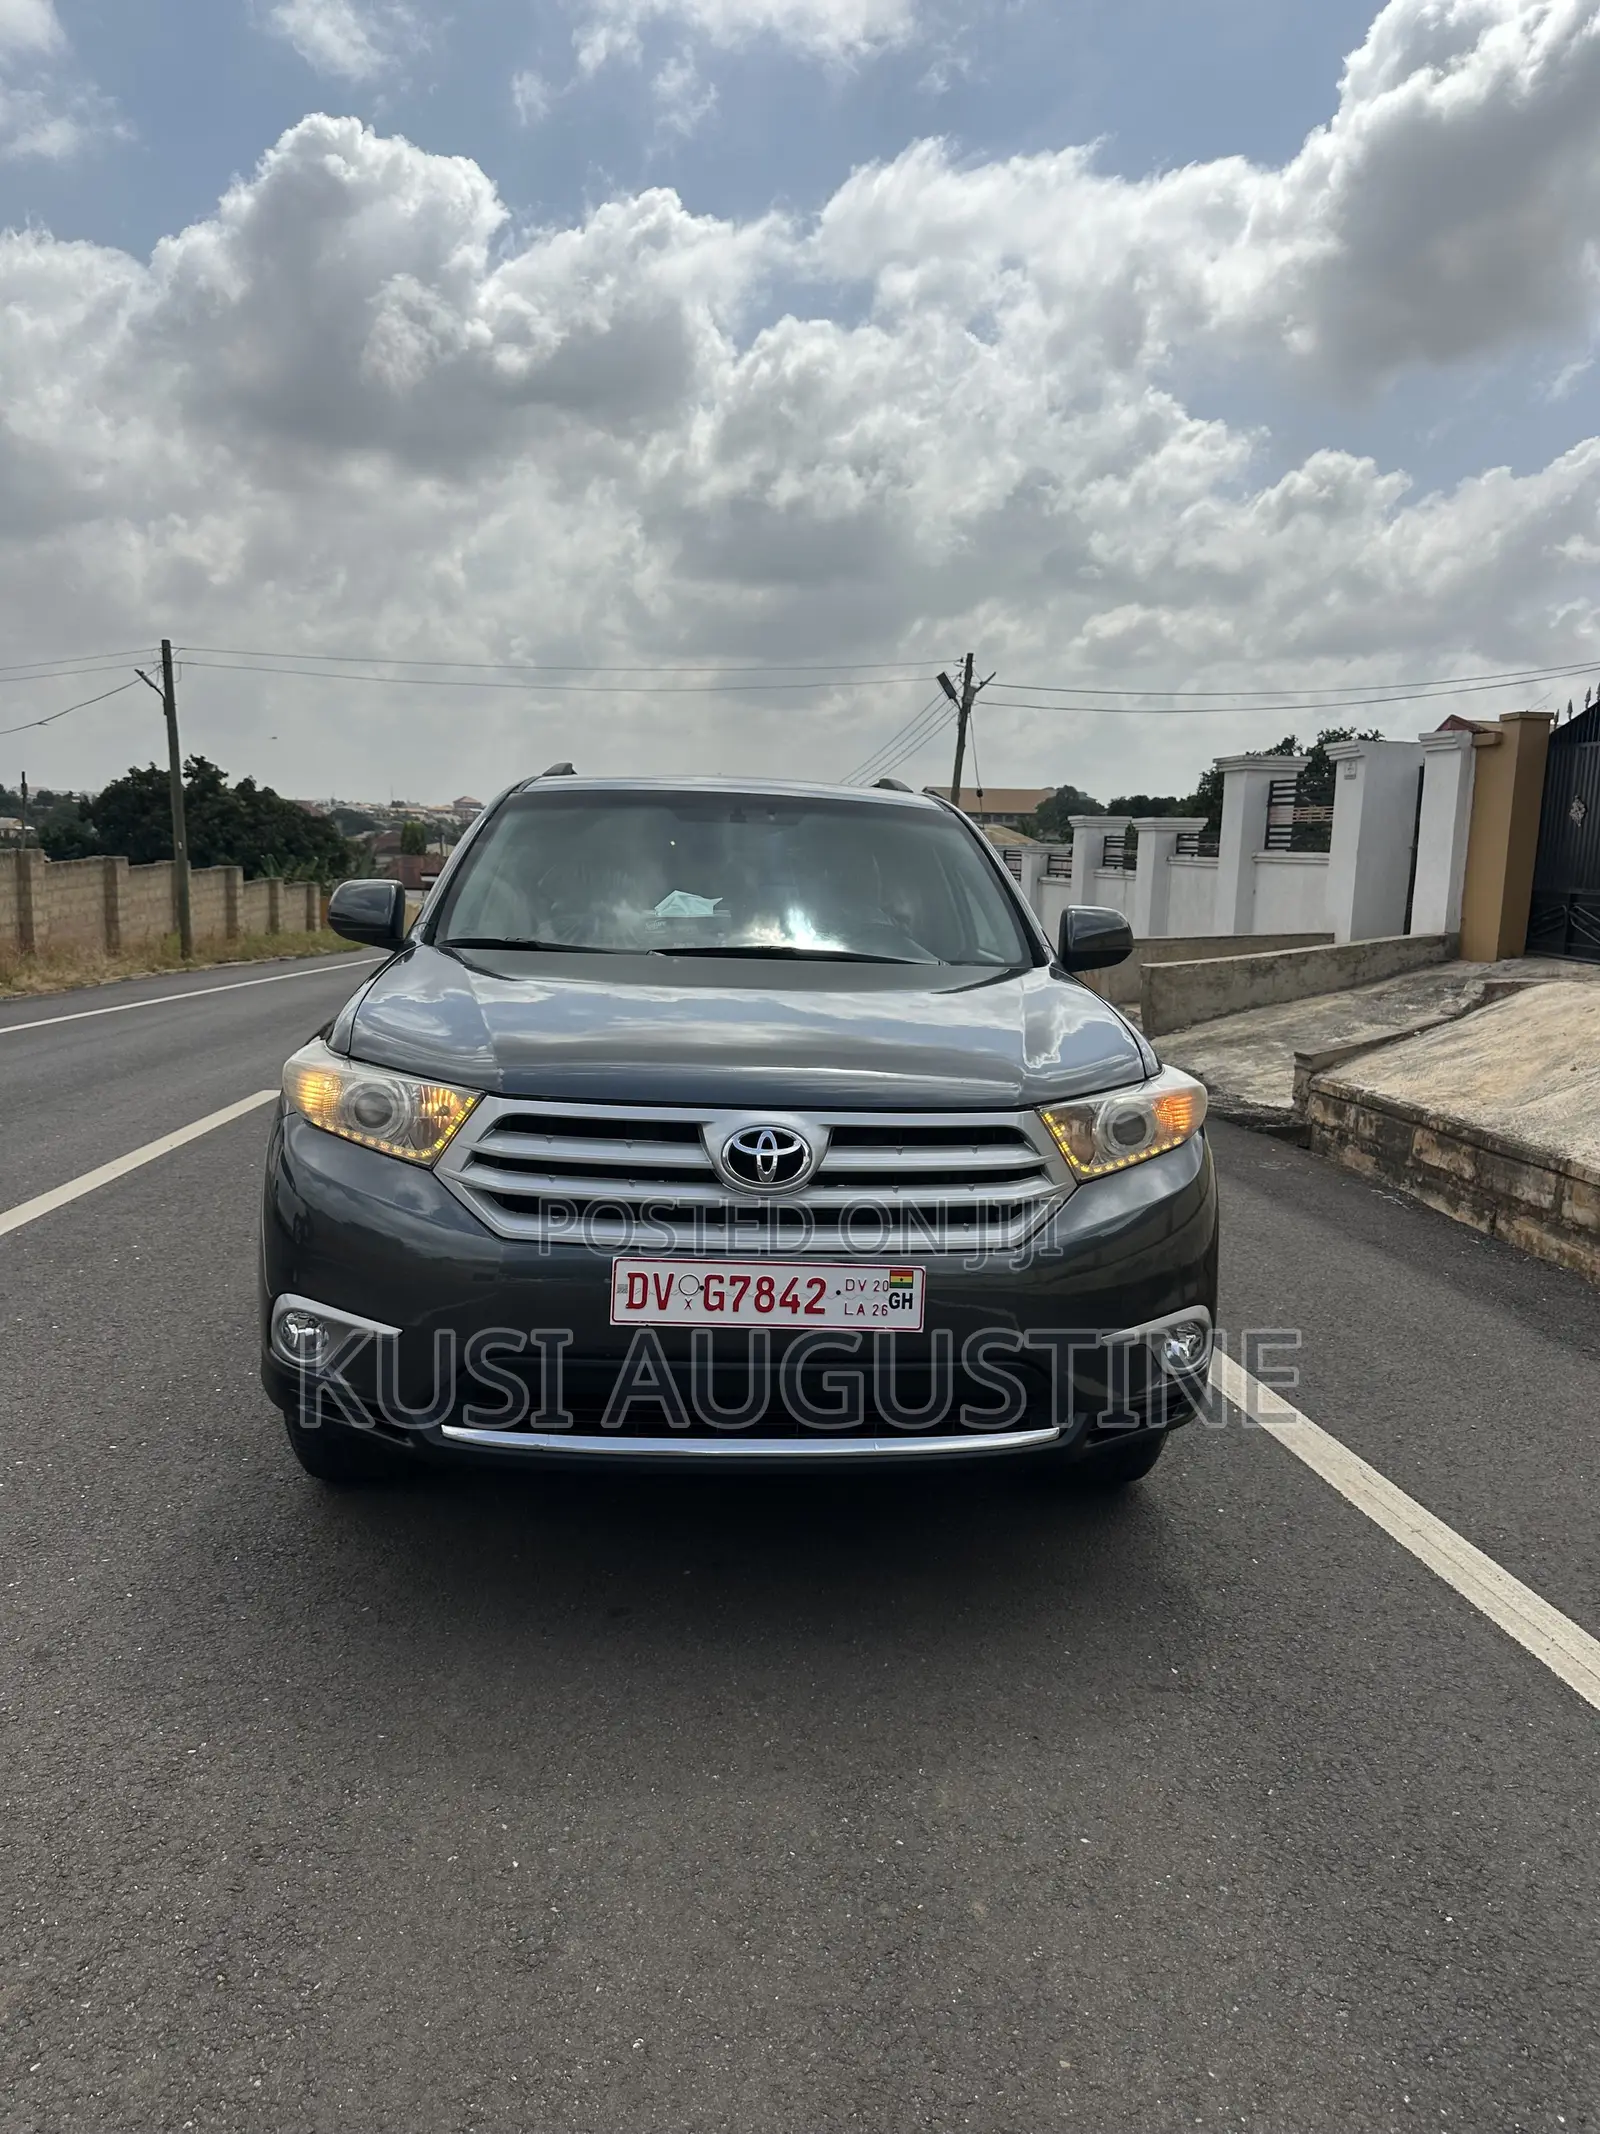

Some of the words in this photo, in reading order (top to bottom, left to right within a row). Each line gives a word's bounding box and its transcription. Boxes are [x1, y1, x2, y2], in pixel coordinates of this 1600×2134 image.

[845, 1278, 867, 1291] DV
[873, 1280, 888, 1292] 20
[624, 1272, 675, 1310] DV
[703, 1274, 826, 1315] G7842
[888, 1292, 913, 1310] GH
[844, 1302, 865, 1315] LA
[872, 1304, 888, 1316] 26
